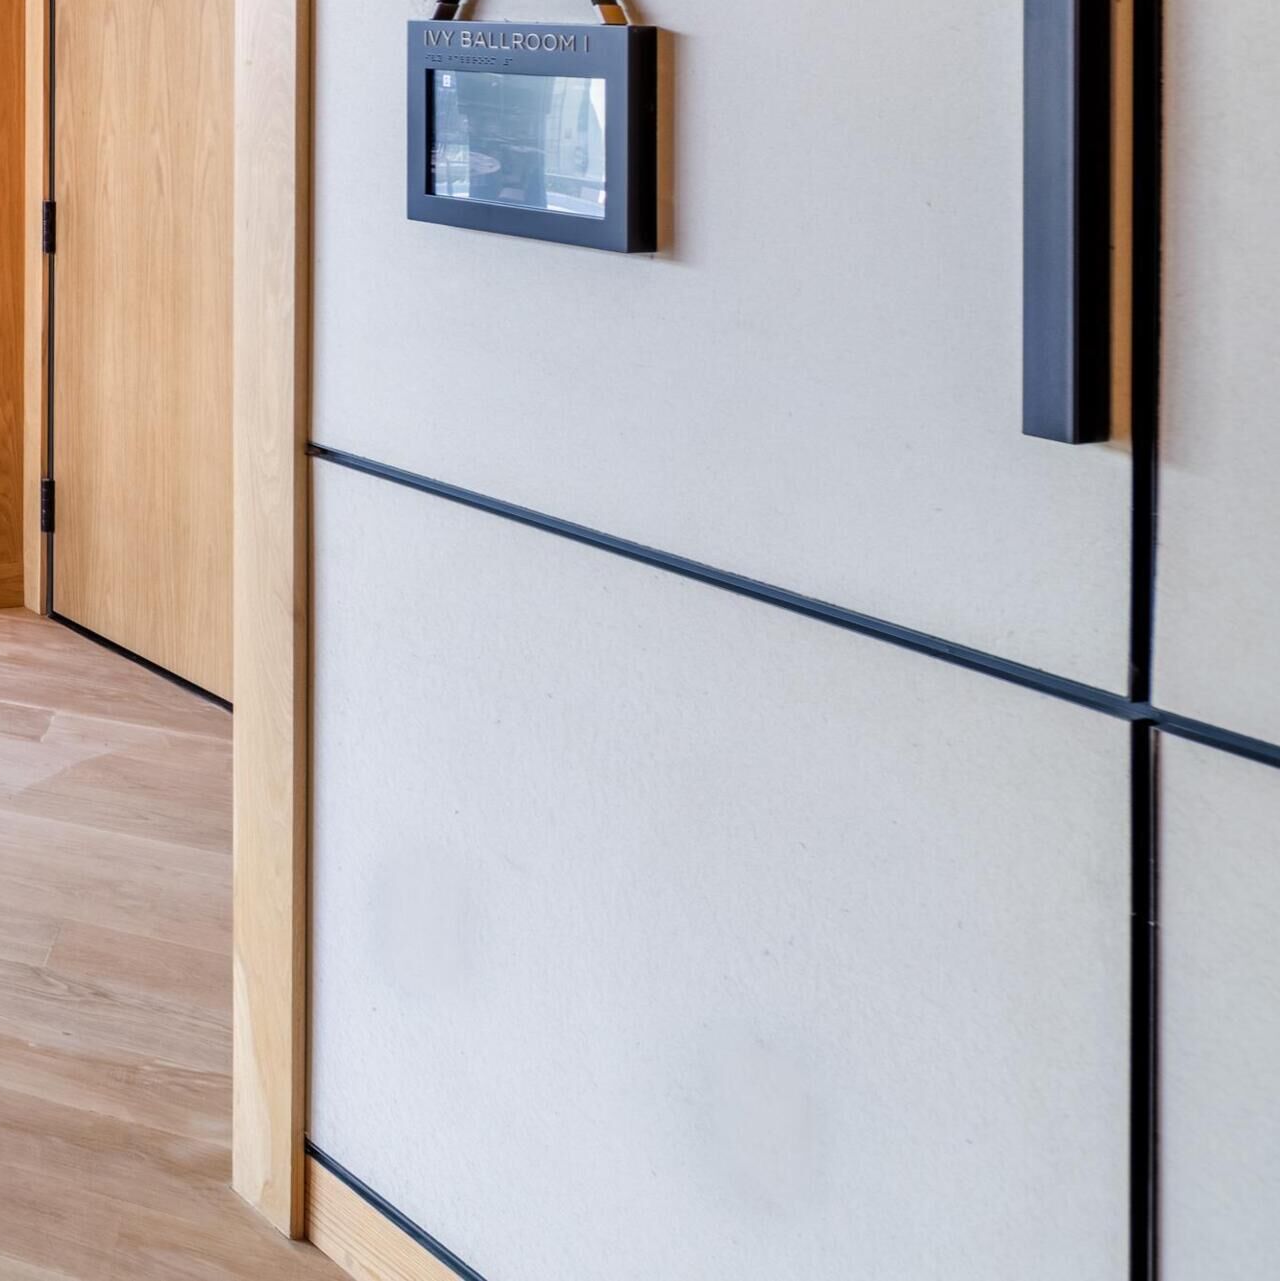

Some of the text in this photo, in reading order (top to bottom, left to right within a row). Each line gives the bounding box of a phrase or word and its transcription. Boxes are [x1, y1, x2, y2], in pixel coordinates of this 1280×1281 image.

[423, 29, 589, 53] IVY BALLROOM I
